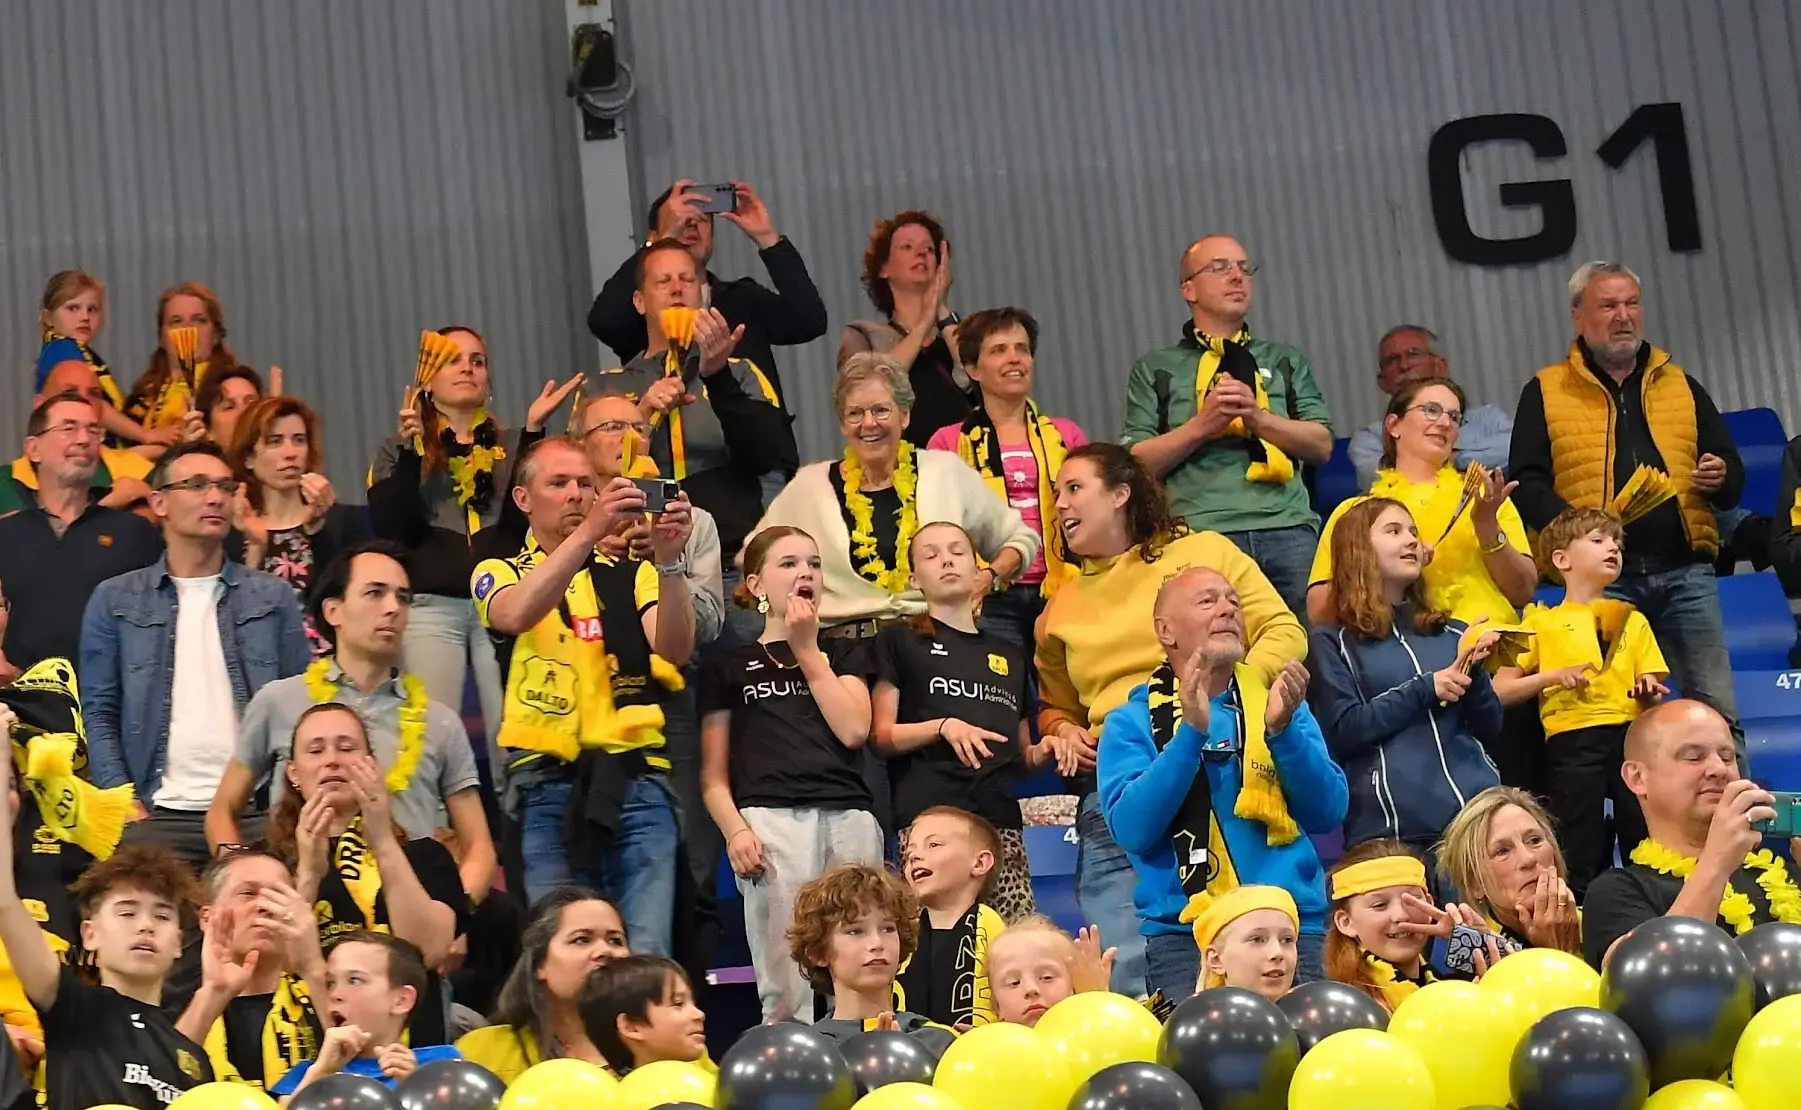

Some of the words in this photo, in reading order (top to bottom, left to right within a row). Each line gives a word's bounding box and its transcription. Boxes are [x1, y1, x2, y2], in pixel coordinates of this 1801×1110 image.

[1429, 103, 1701, 266] G1
[575, 620, 602, 641] BA
[929, 676, 979, 699] ASU
[525, 689, 569, 710] DALTO
